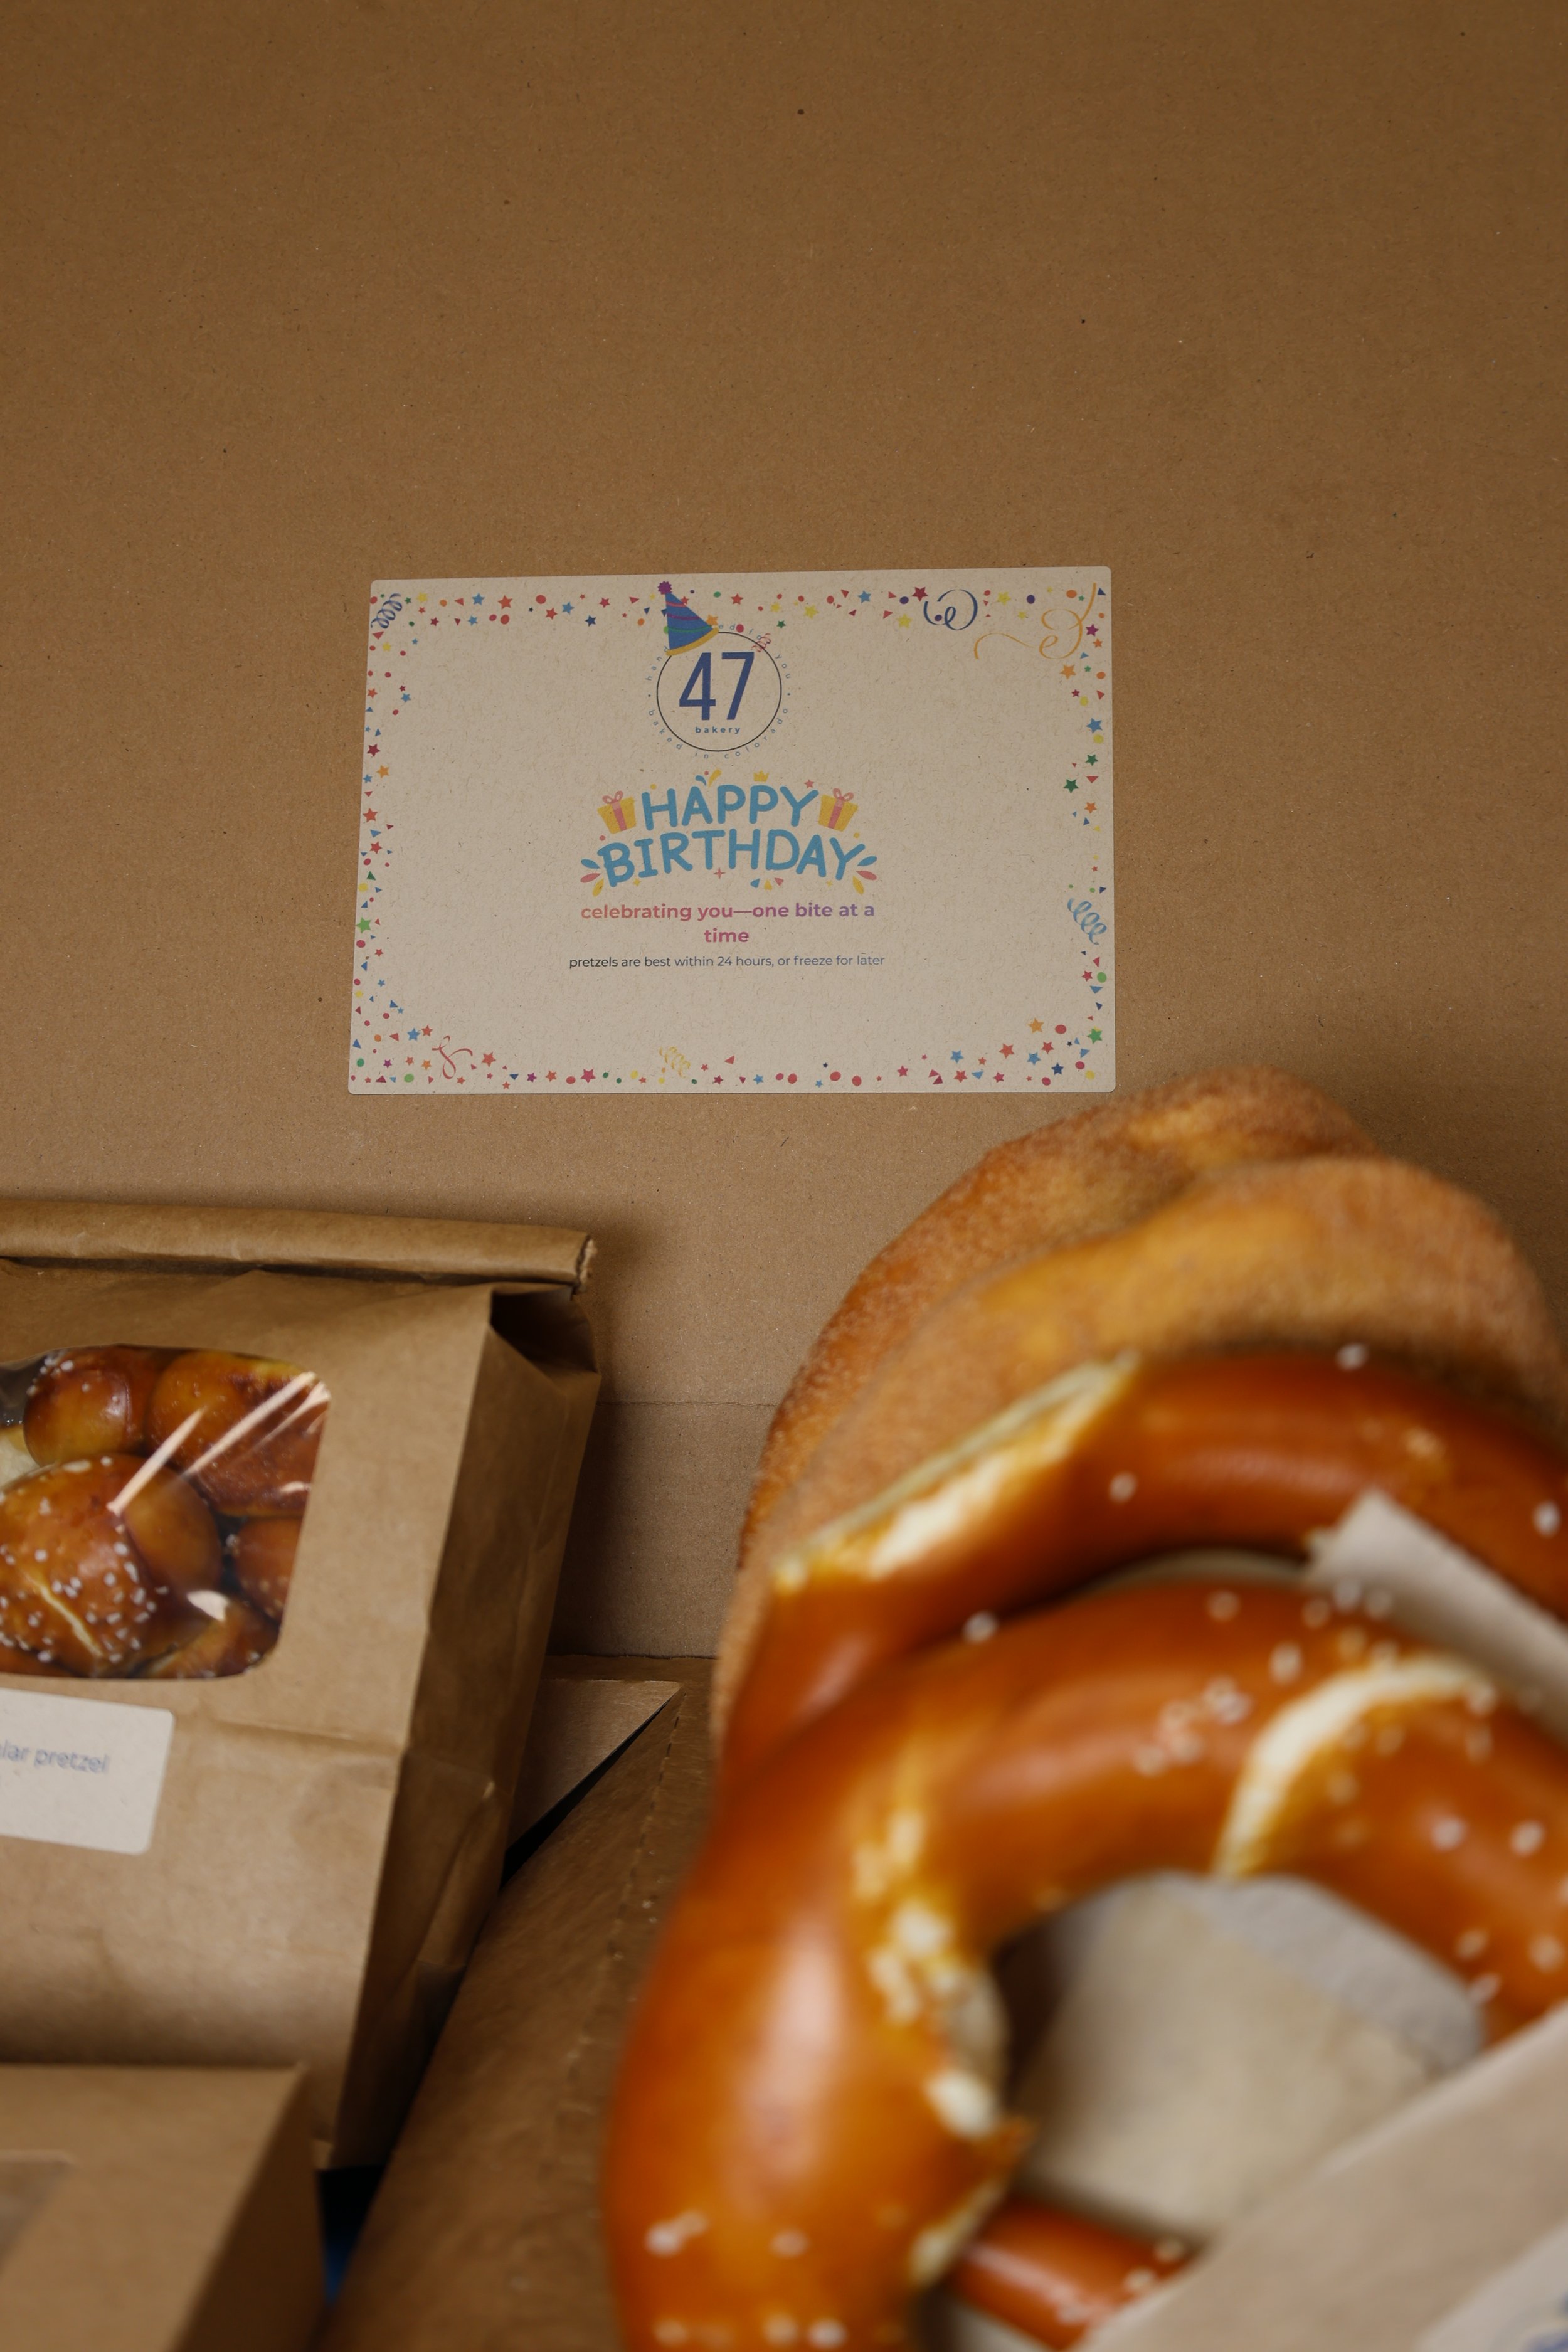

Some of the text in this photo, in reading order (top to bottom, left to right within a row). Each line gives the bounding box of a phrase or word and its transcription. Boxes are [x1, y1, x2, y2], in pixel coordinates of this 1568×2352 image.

[775, 654, 790, 679] you
[679, 652, 755, 721] 47
[648, 709, 684, 750] baked
[724, 708, 788, 759] colorado
[695, 726, 741, 734] bakery
[641, 784, 819, 831] HAPPY
[596, 829, 866, 887] BIRTHDAY
[581, 903, 691, 921] celebrating
[795, 903, 833, 917] bite
[839, 904, 858, 916] at
[864, 906, 875, 916] a
[704, 928, 750, 943] time
[569, 956, 618, 969] pretzels
[644, 956, 671, 967] best
[674, 956, 714, 967] within
[717, 956, 733, 967] 24
[736, 956, 775, 967] hours,
[777, 958, 790, 966] or
[794, 955, 833, 966] freeze
[836, 955, 854, 966] for
[857, 955, 886, 965] later
[34, 1749, 110, 1775] pretzel
